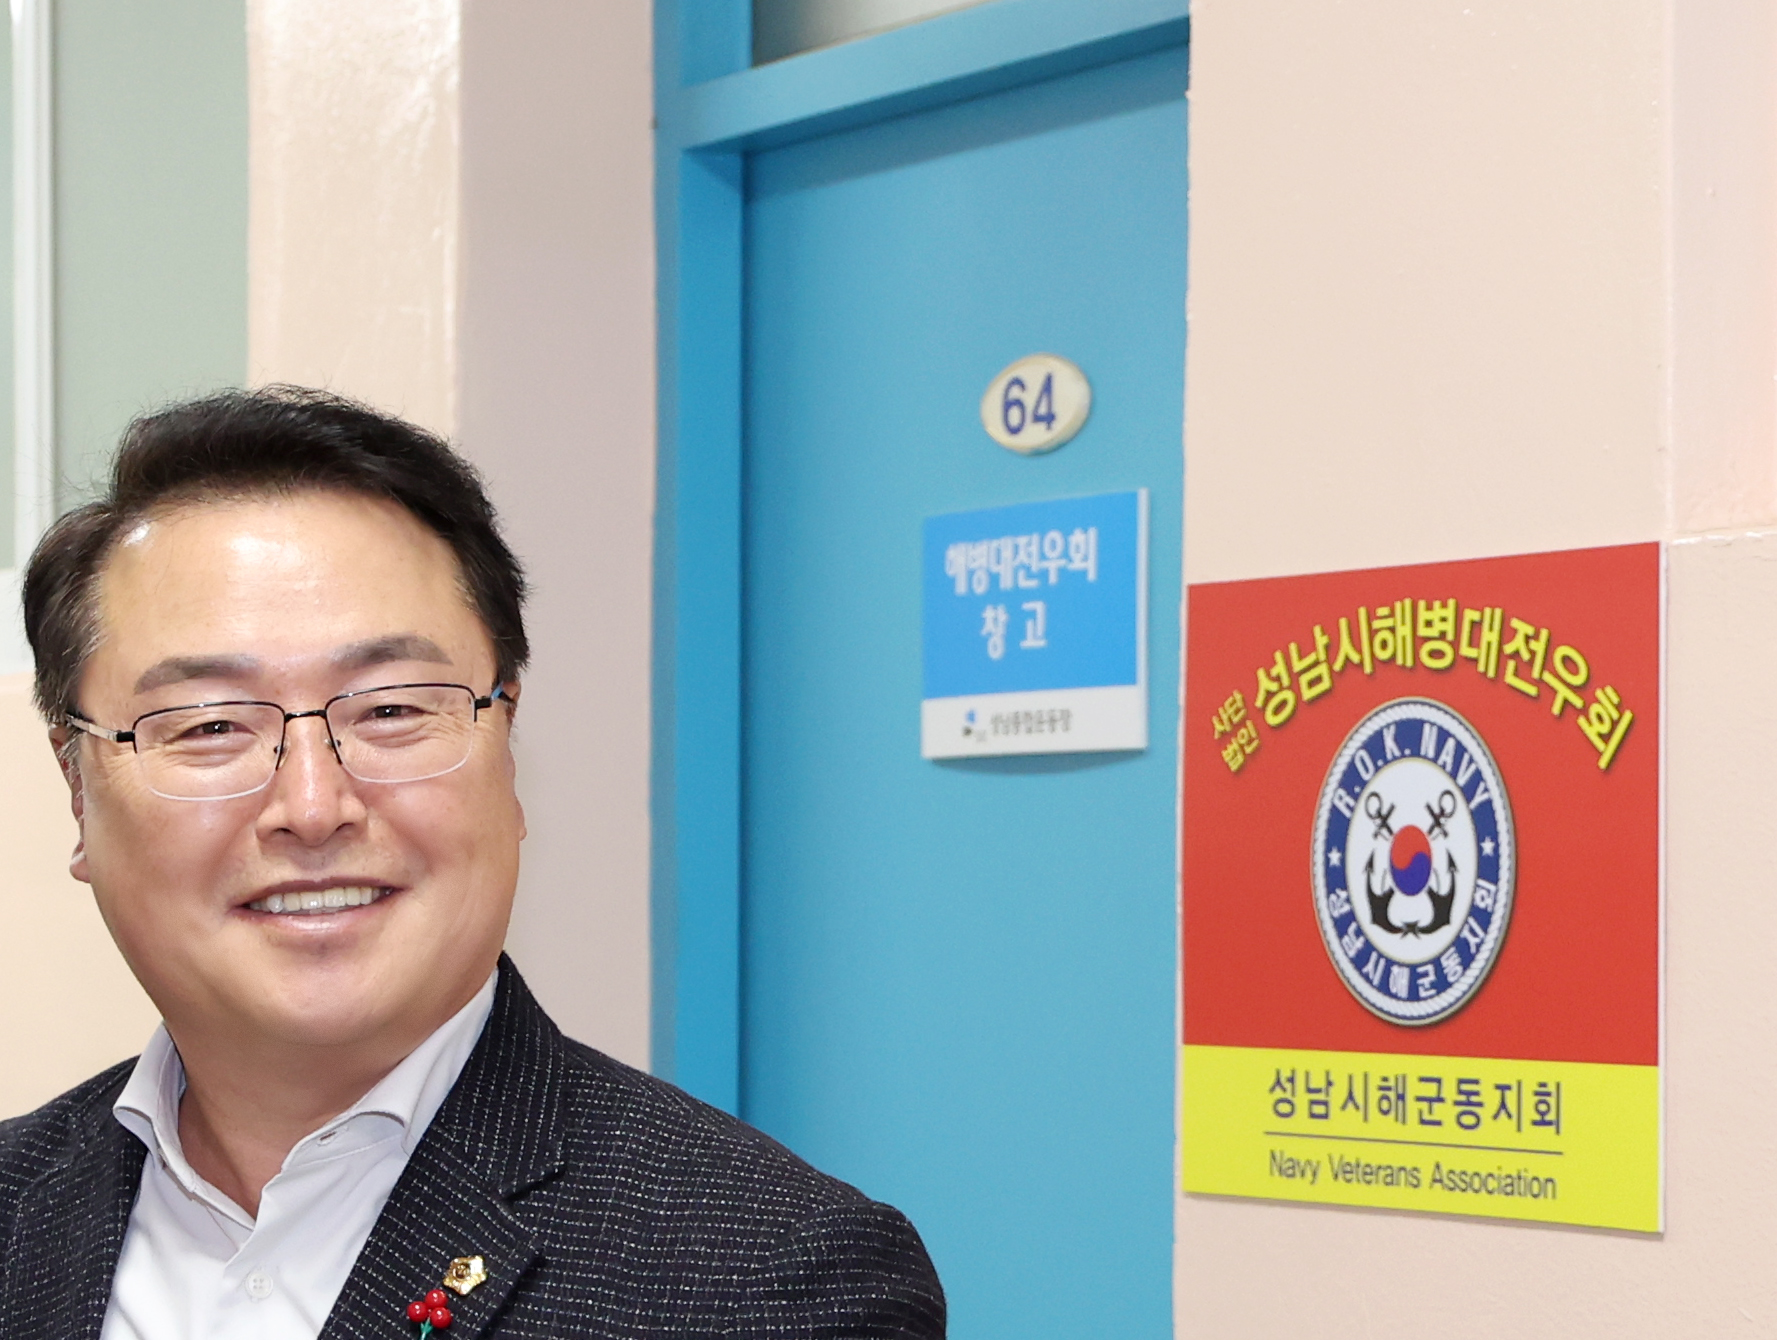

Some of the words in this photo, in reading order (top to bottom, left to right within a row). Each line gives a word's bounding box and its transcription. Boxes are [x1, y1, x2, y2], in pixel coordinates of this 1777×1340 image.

[1001, 372, 1057, 436] 64
[945, 526, 1098, 595] 해병대전우회
[1211, 689, 1247, 740] 사단
[1254, 598, 1633, 770] 성남시해병대전우회
[1221, 719, 1260, 772] 법인
[1332, 723, 1411, 819] R.O.K.
[1420, 722, 1491, 811] NAVY
[1328, 879, 1496, 1000] 성남시해군동지회
[1269, 1068, 1562, 1135] 성남시해군동지회
[1269, 1150, 1321, 1185] Navy
[1327, 1153, 1422, 1189] Veterans
[1430, 1161, 1558, 1200] Association
